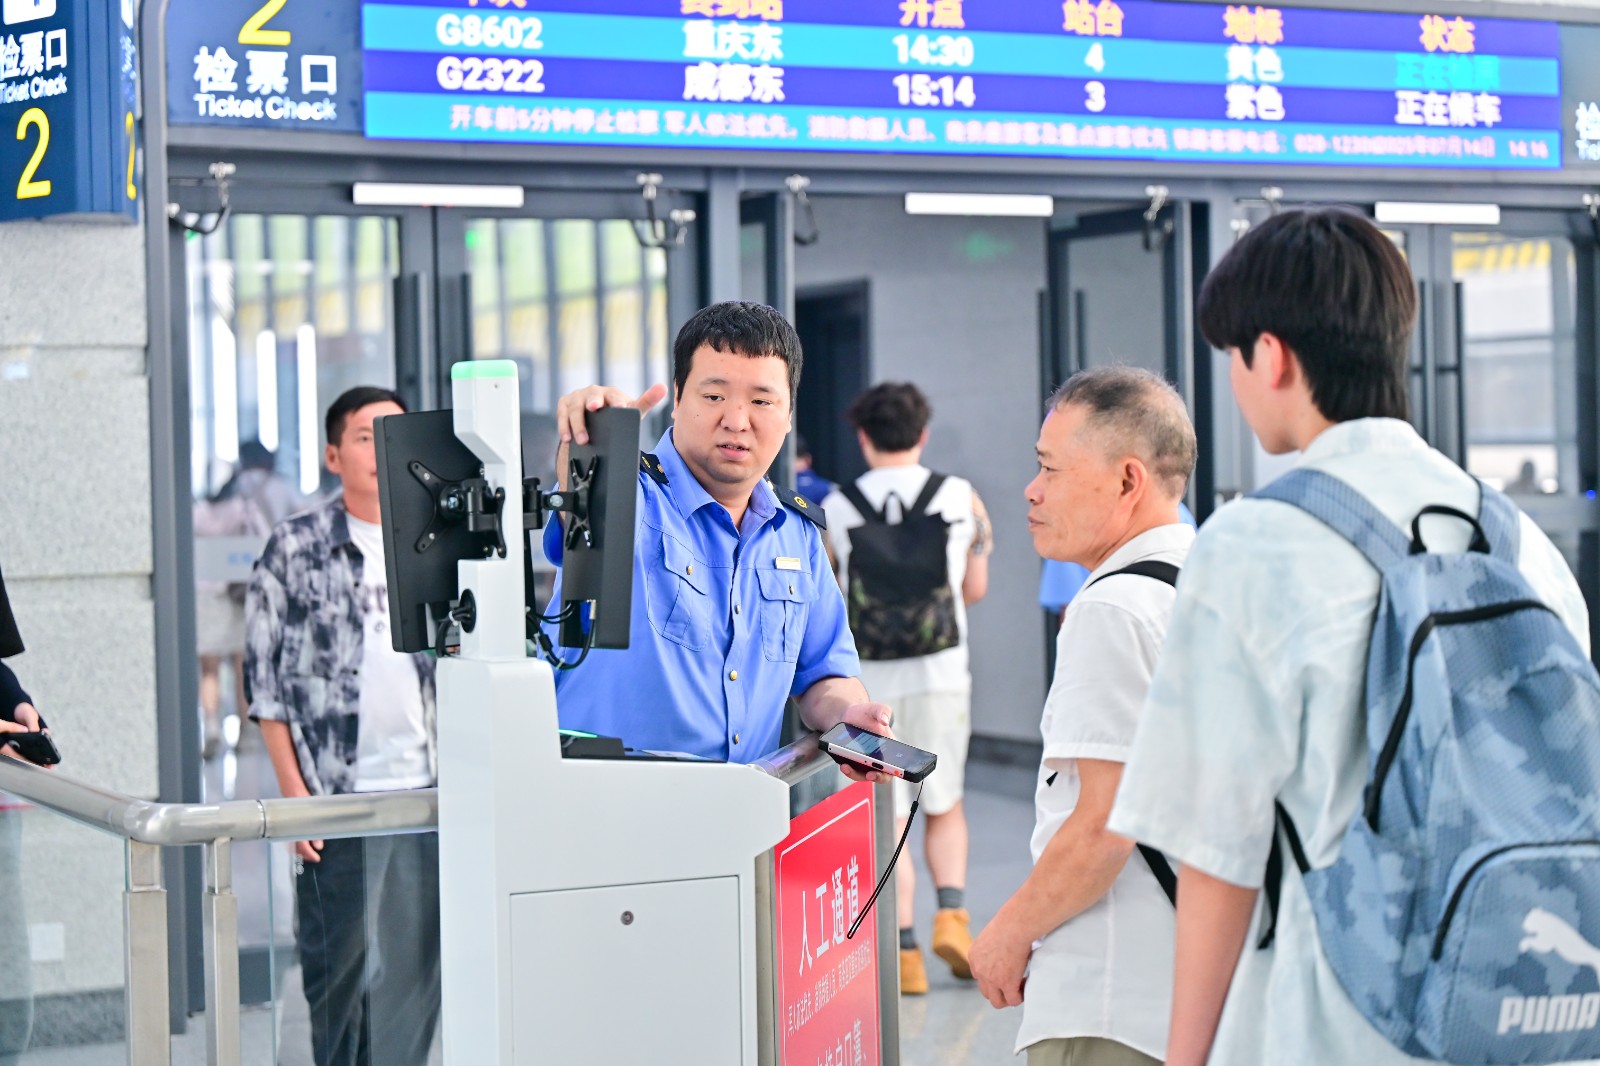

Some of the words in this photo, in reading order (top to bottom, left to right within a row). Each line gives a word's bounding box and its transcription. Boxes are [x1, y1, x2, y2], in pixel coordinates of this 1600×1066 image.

[1062, 0, 1124, 37] 站台
[0, 28, 67, 80] 检票口
[193, 46, 337, 95] 检票口
[436, 13, 543, 49] G8602
[682, 19, 783, 61] 重庆东
[892, 33, 974, 66] 14:30
[1084, 42, 1105, 72] 4
[1224, 43, 1284, 82] 黄色
[193, 94, 264, 119] Ticket
[265, 96, 337, 121] Check
[436, 56, 545, 93] G2322
[682, 62, 785, 102] 成都东
[892, 74, 976, 107] 15:14
[1084, 80, 1106, 112] 3
[1394, 90, 1502, 127] 正在候车
[16, 107, 51, 199] 2
[798, 854, 860, 977] 人工通道
[1497, 992, 1600, 1035] PUMA
